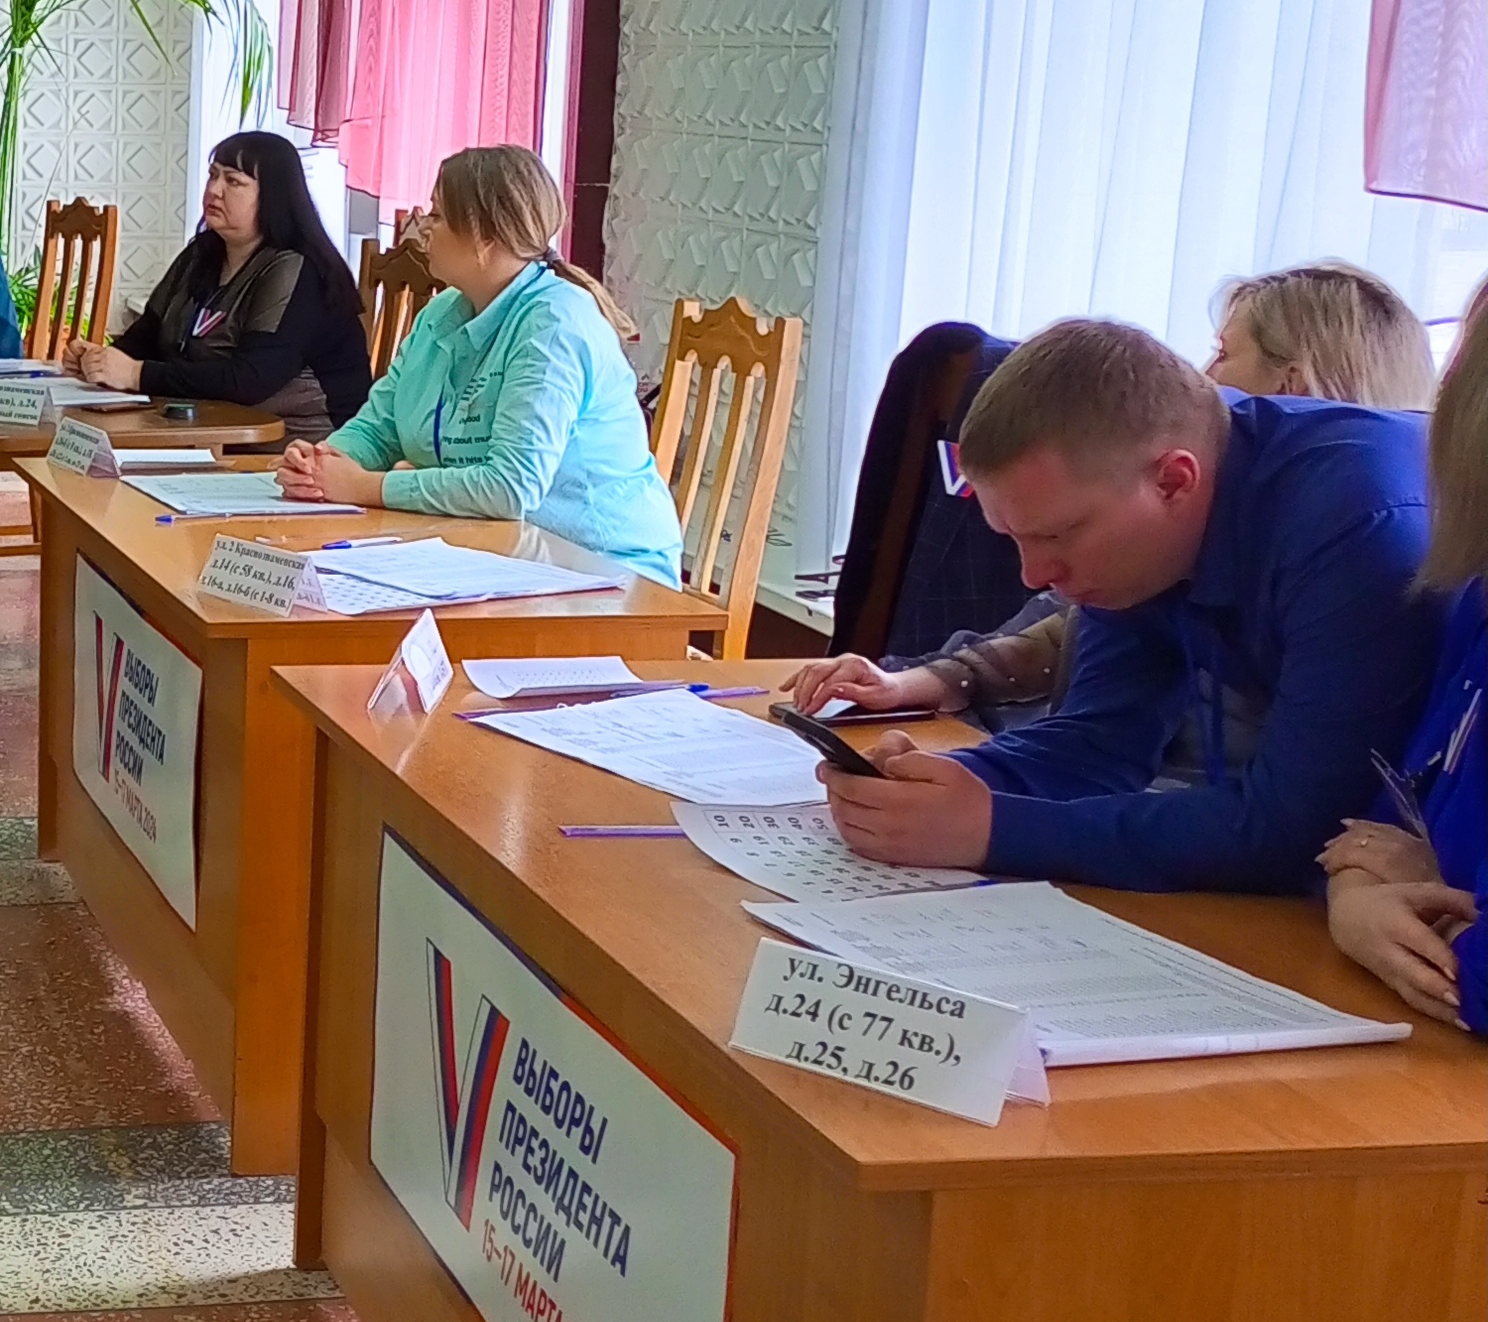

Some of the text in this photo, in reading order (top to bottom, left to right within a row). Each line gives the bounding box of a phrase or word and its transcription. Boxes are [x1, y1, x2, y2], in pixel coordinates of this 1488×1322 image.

[124, 648, 159, 707] ВЫБОРЫ
[118, 688, 166, 766] ПРЕЗИДЕНТА
[115, 730, 144, 787] РОССИИ
[713, 815, 730, 828] 10
[738, 815, 755, 829] 20
[763, 816, 780, 830] 30
[787, 817, 803, 830] 40
[812, 817, 829, 831] 50
[782, 956, 966, 1020] ул. Энгельса
[764, 992, 963, 1067] д.24 (с 77 кв.),
[785, 1039, 919, 1092] д.25, д.26
[512, 1036, 608, 1165] ВЫБОРЫ
[498, 1098, 635, 1278] ПРЕЗИДЕНТА
[488, 1160, 567, 1284] РОССИИ
